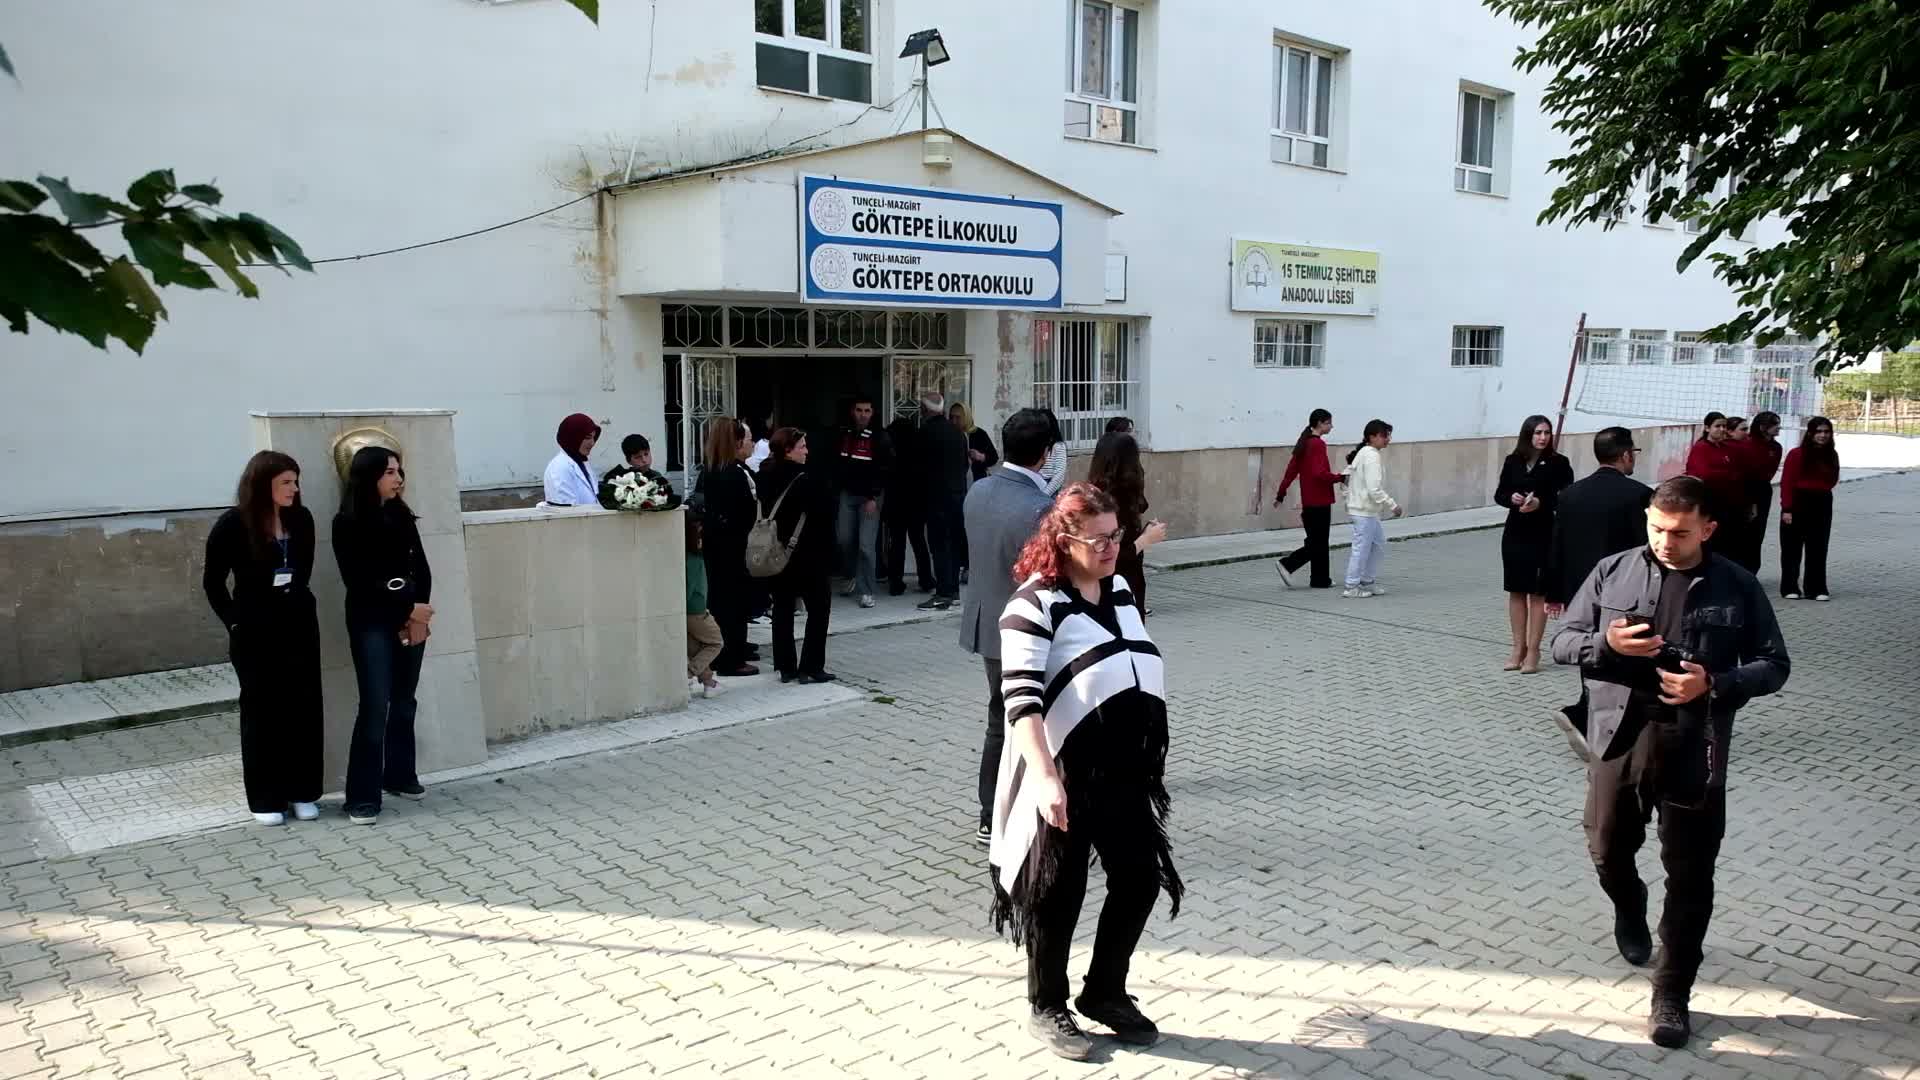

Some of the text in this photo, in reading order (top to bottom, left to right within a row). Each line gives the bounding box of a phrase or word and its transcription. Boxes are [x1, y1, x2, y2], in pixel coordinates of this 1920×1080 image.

[852, 208, 1018, 244] GÖKTEPE İLKOKULU
[852, 264, 1033, 295] GÖKTEPE ORTAOKULU
[1281, 263, 1377, 285] 15 TEMMUZ ŞEHİTLER
[1281, 286, 1354, 305] ANADOLU LİSESİ
